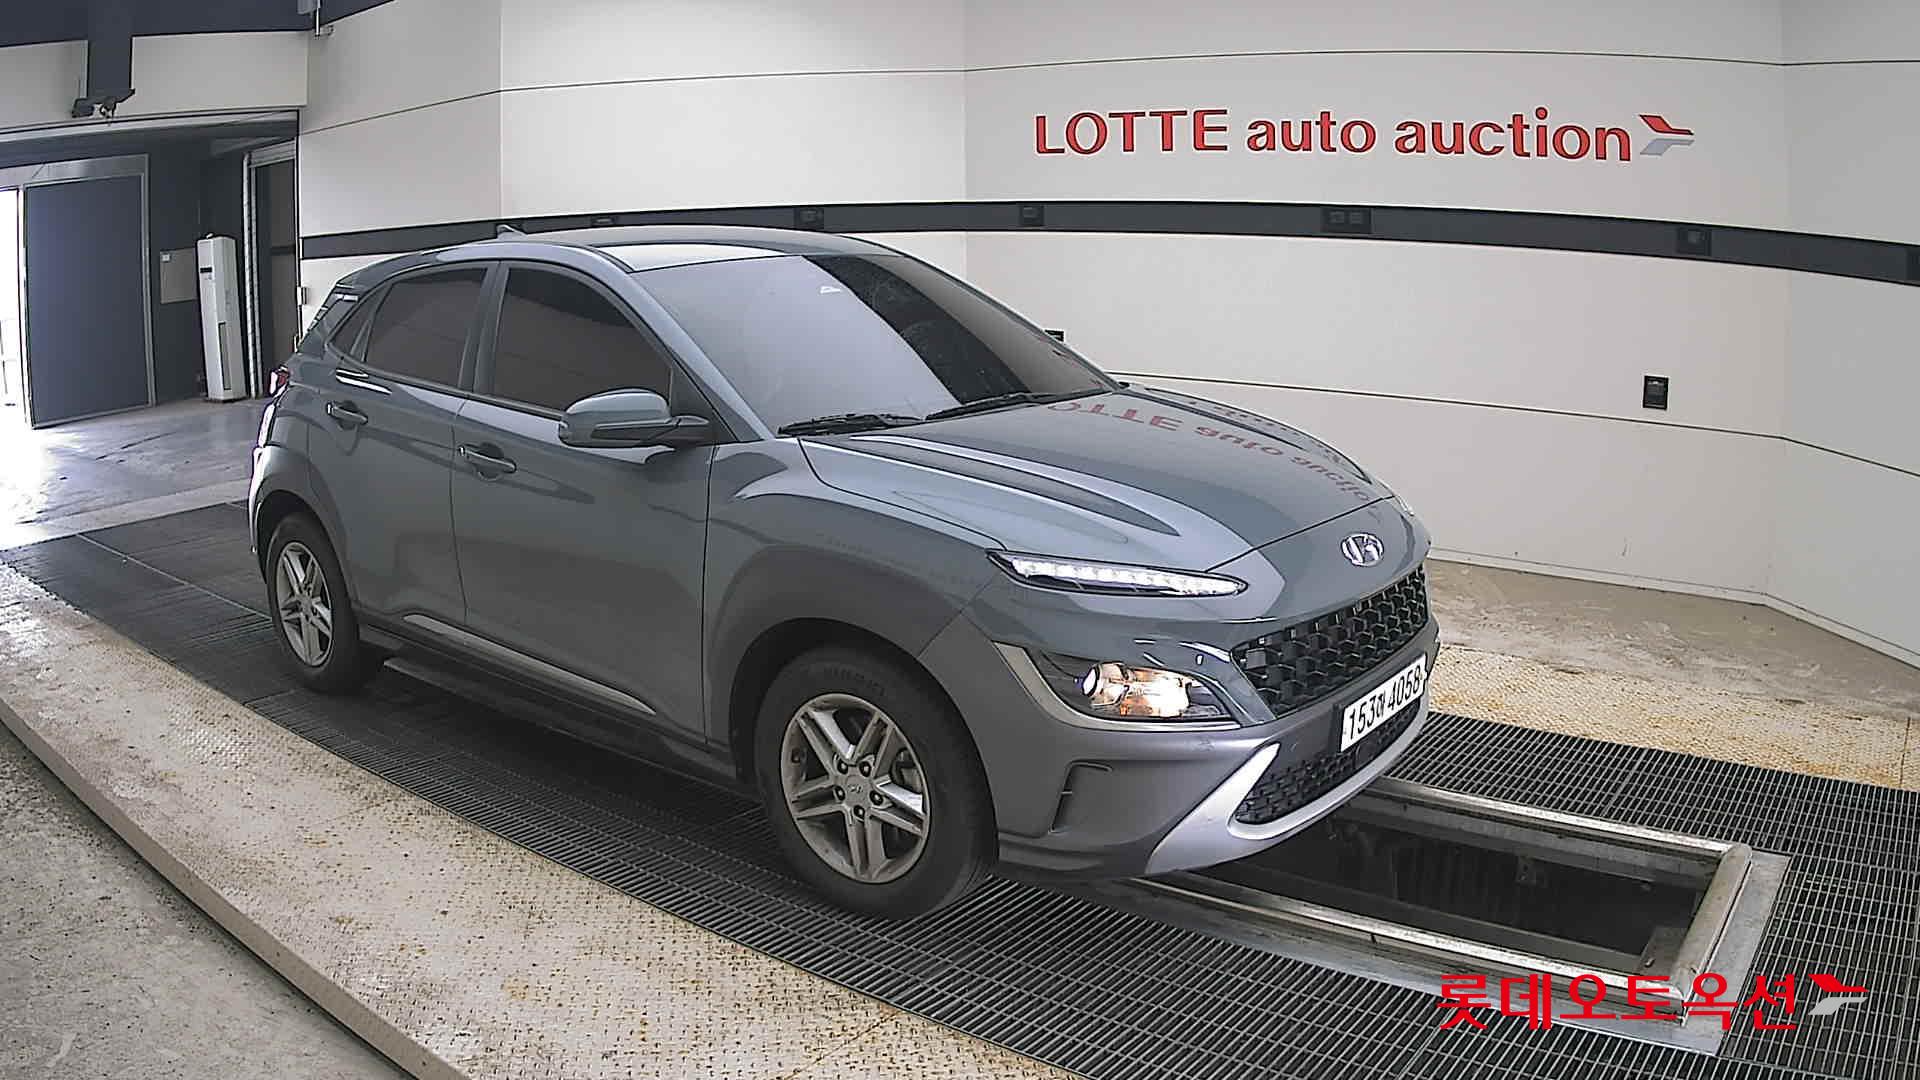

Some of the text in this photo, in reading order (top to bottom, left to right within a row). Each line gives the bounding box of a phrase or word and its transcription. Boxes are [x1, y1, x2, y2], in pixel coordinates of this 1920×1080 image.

[1034, 106, 1632, 162] LOTTE auto auction
[1387, 665, 1421, 710] 4058
